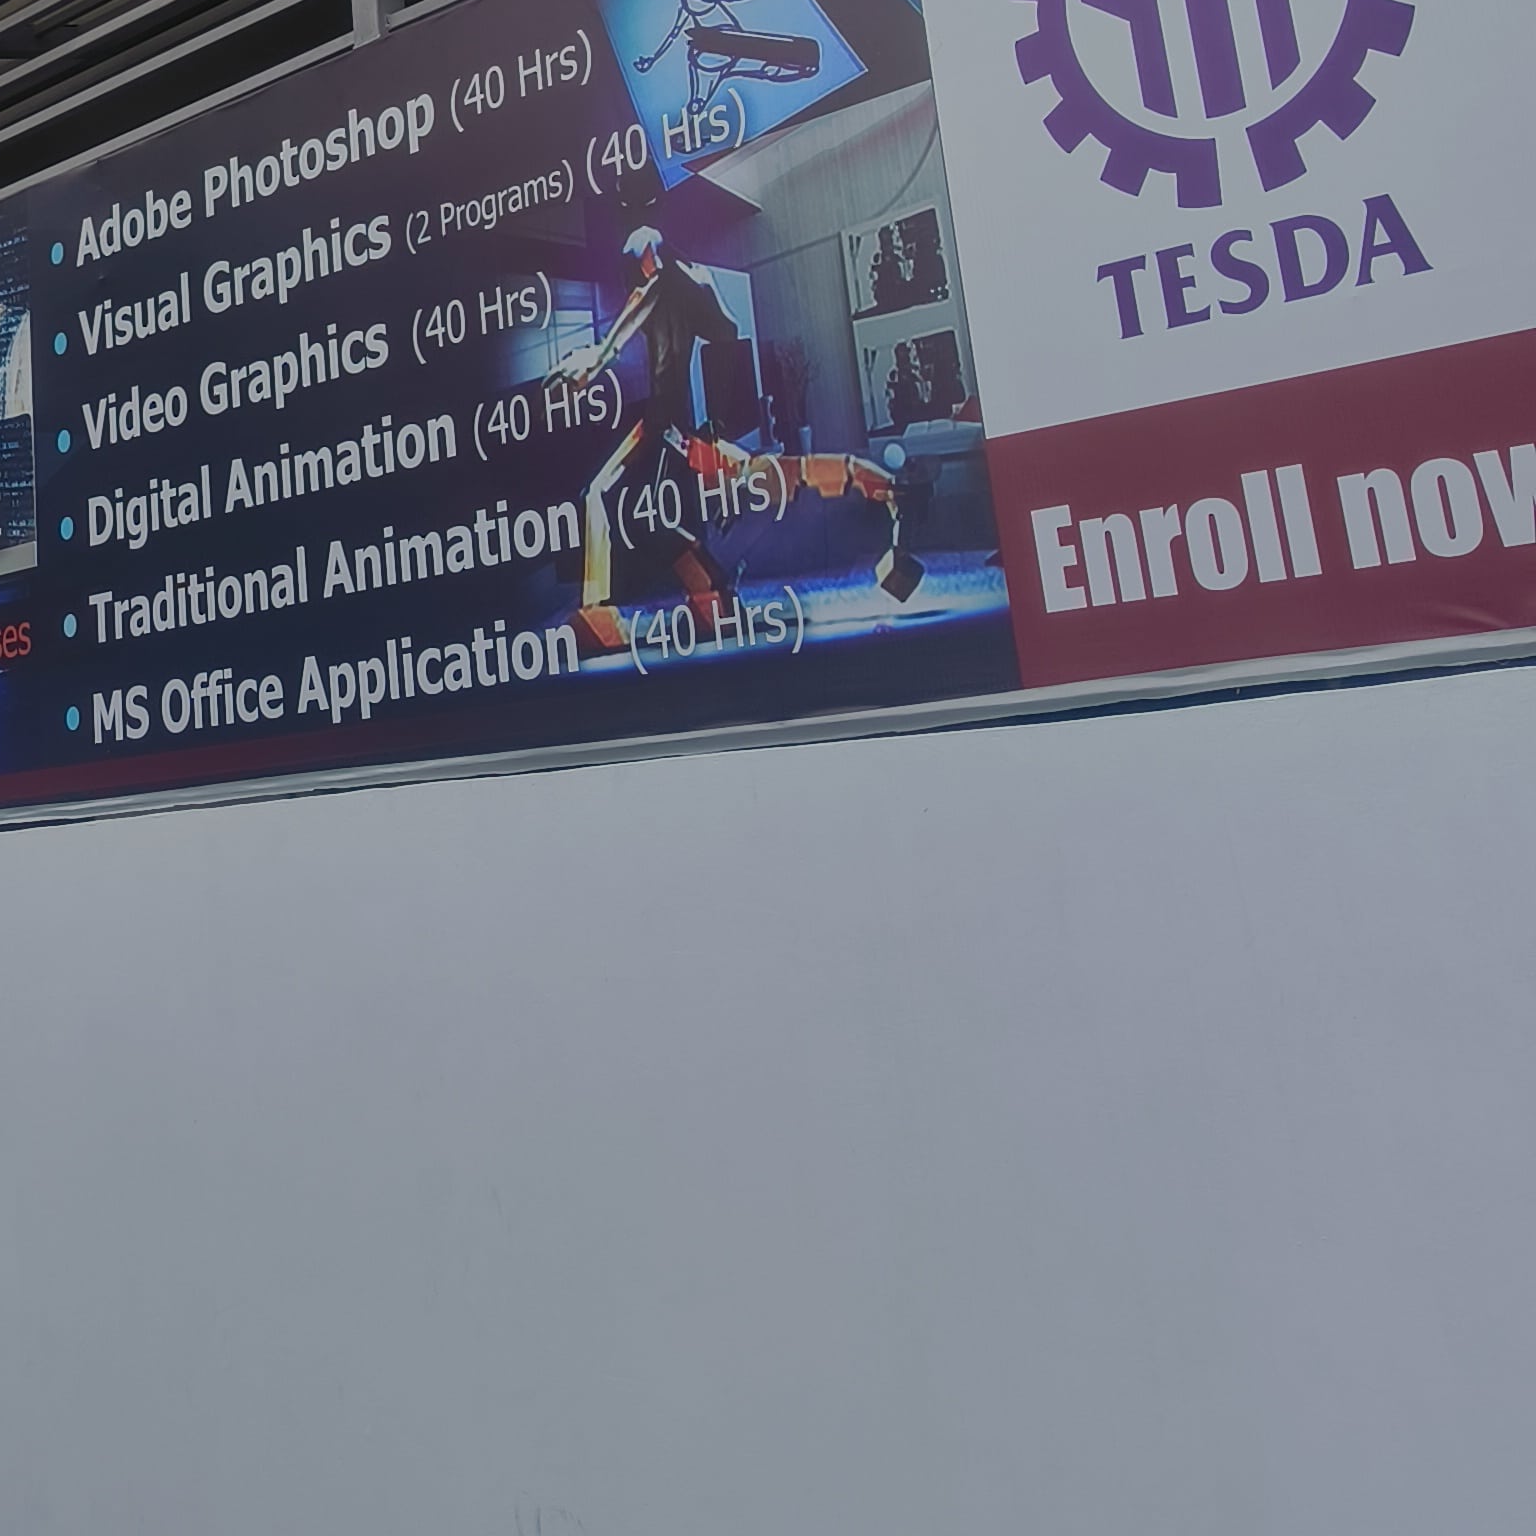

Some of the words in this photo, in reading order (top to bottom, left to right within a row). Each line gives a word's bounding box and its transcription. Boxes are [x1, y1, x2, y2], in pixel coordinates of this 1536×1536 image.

[76, 190, 192, 267] Adobe
[204, 90, 435, 216] Photoshop
[448, 64, 504, 132] (40
[517, 29, 593, 96] Hrs)
[78, 273, 190, 357] Visual
[202, 212, 392, 314] Graphics
[405, 209, 431, 255] (2
[440, 159, 574, 236] Programs)
[585, 123, 647, 195] (40
[662, 88, 747, 160] Hrs)
[1096, 193, 1433, 339] TESDA
[82, 384, 188, 450] Video
[199, 322, 389, 415] Graphics
[411, 299, 466, 364] (40
[478, 271, 554, 334] Hrs)
[88, 465, 212, 550] Digital
[225, 413, 457, 513] Animation
[472, 395, 532, 461] (40
[545, 368, 622, 435] Hrs)
[89, 546, 307, 646] Traditional
[323, 492, 580, 599] Animation
[616, 478, 681, 551] (40
[696, 452, 788, 522] Hrs)
[1030, 463, 1323, 614] Enroll
[93, 685, 150, 744] MS
[161, 668, 284, 735] Office
[296, 619, 579, 724] Application
[629, 605, 696, 675] (40
[710, 585, 806, 654] Hrs)
